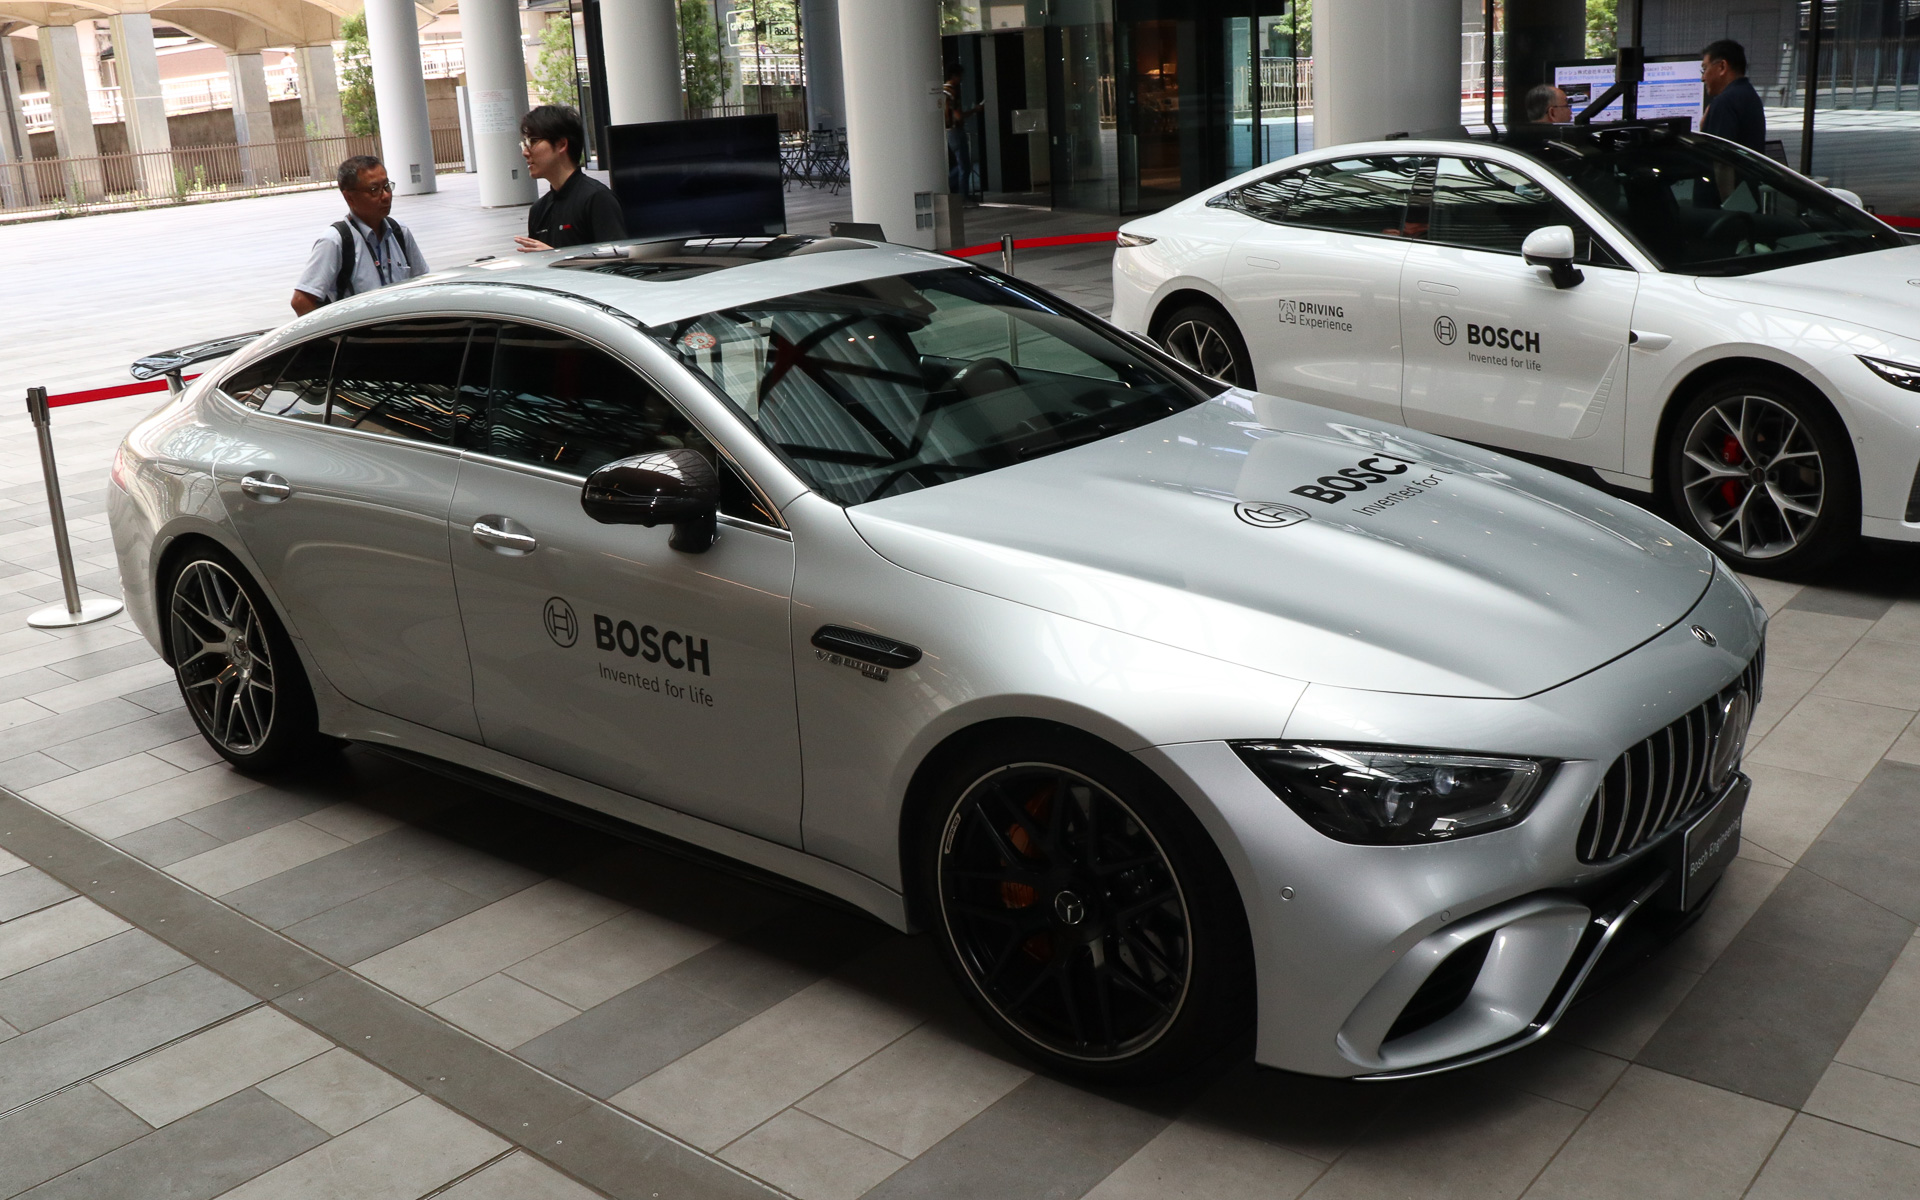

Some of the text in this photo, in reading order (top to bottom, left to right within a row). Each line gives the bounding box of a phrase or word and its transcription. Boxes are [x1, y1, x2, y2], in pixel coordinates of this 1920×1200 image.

[1299, 301, 1344, 318] DRIVING
[1299, 314, 1353, 332] Experience
[1467, 323, 1541, 354] BOSCH
[1468, 351, 1541, 372] Invented for life
[1352, 473, 1443, 517] Invented for
[593, 613, 710, 676] BOSCH
[598, 661, 714, 708] Invented for life
[1689, 815, 1741, 877] Bosch Engineering
